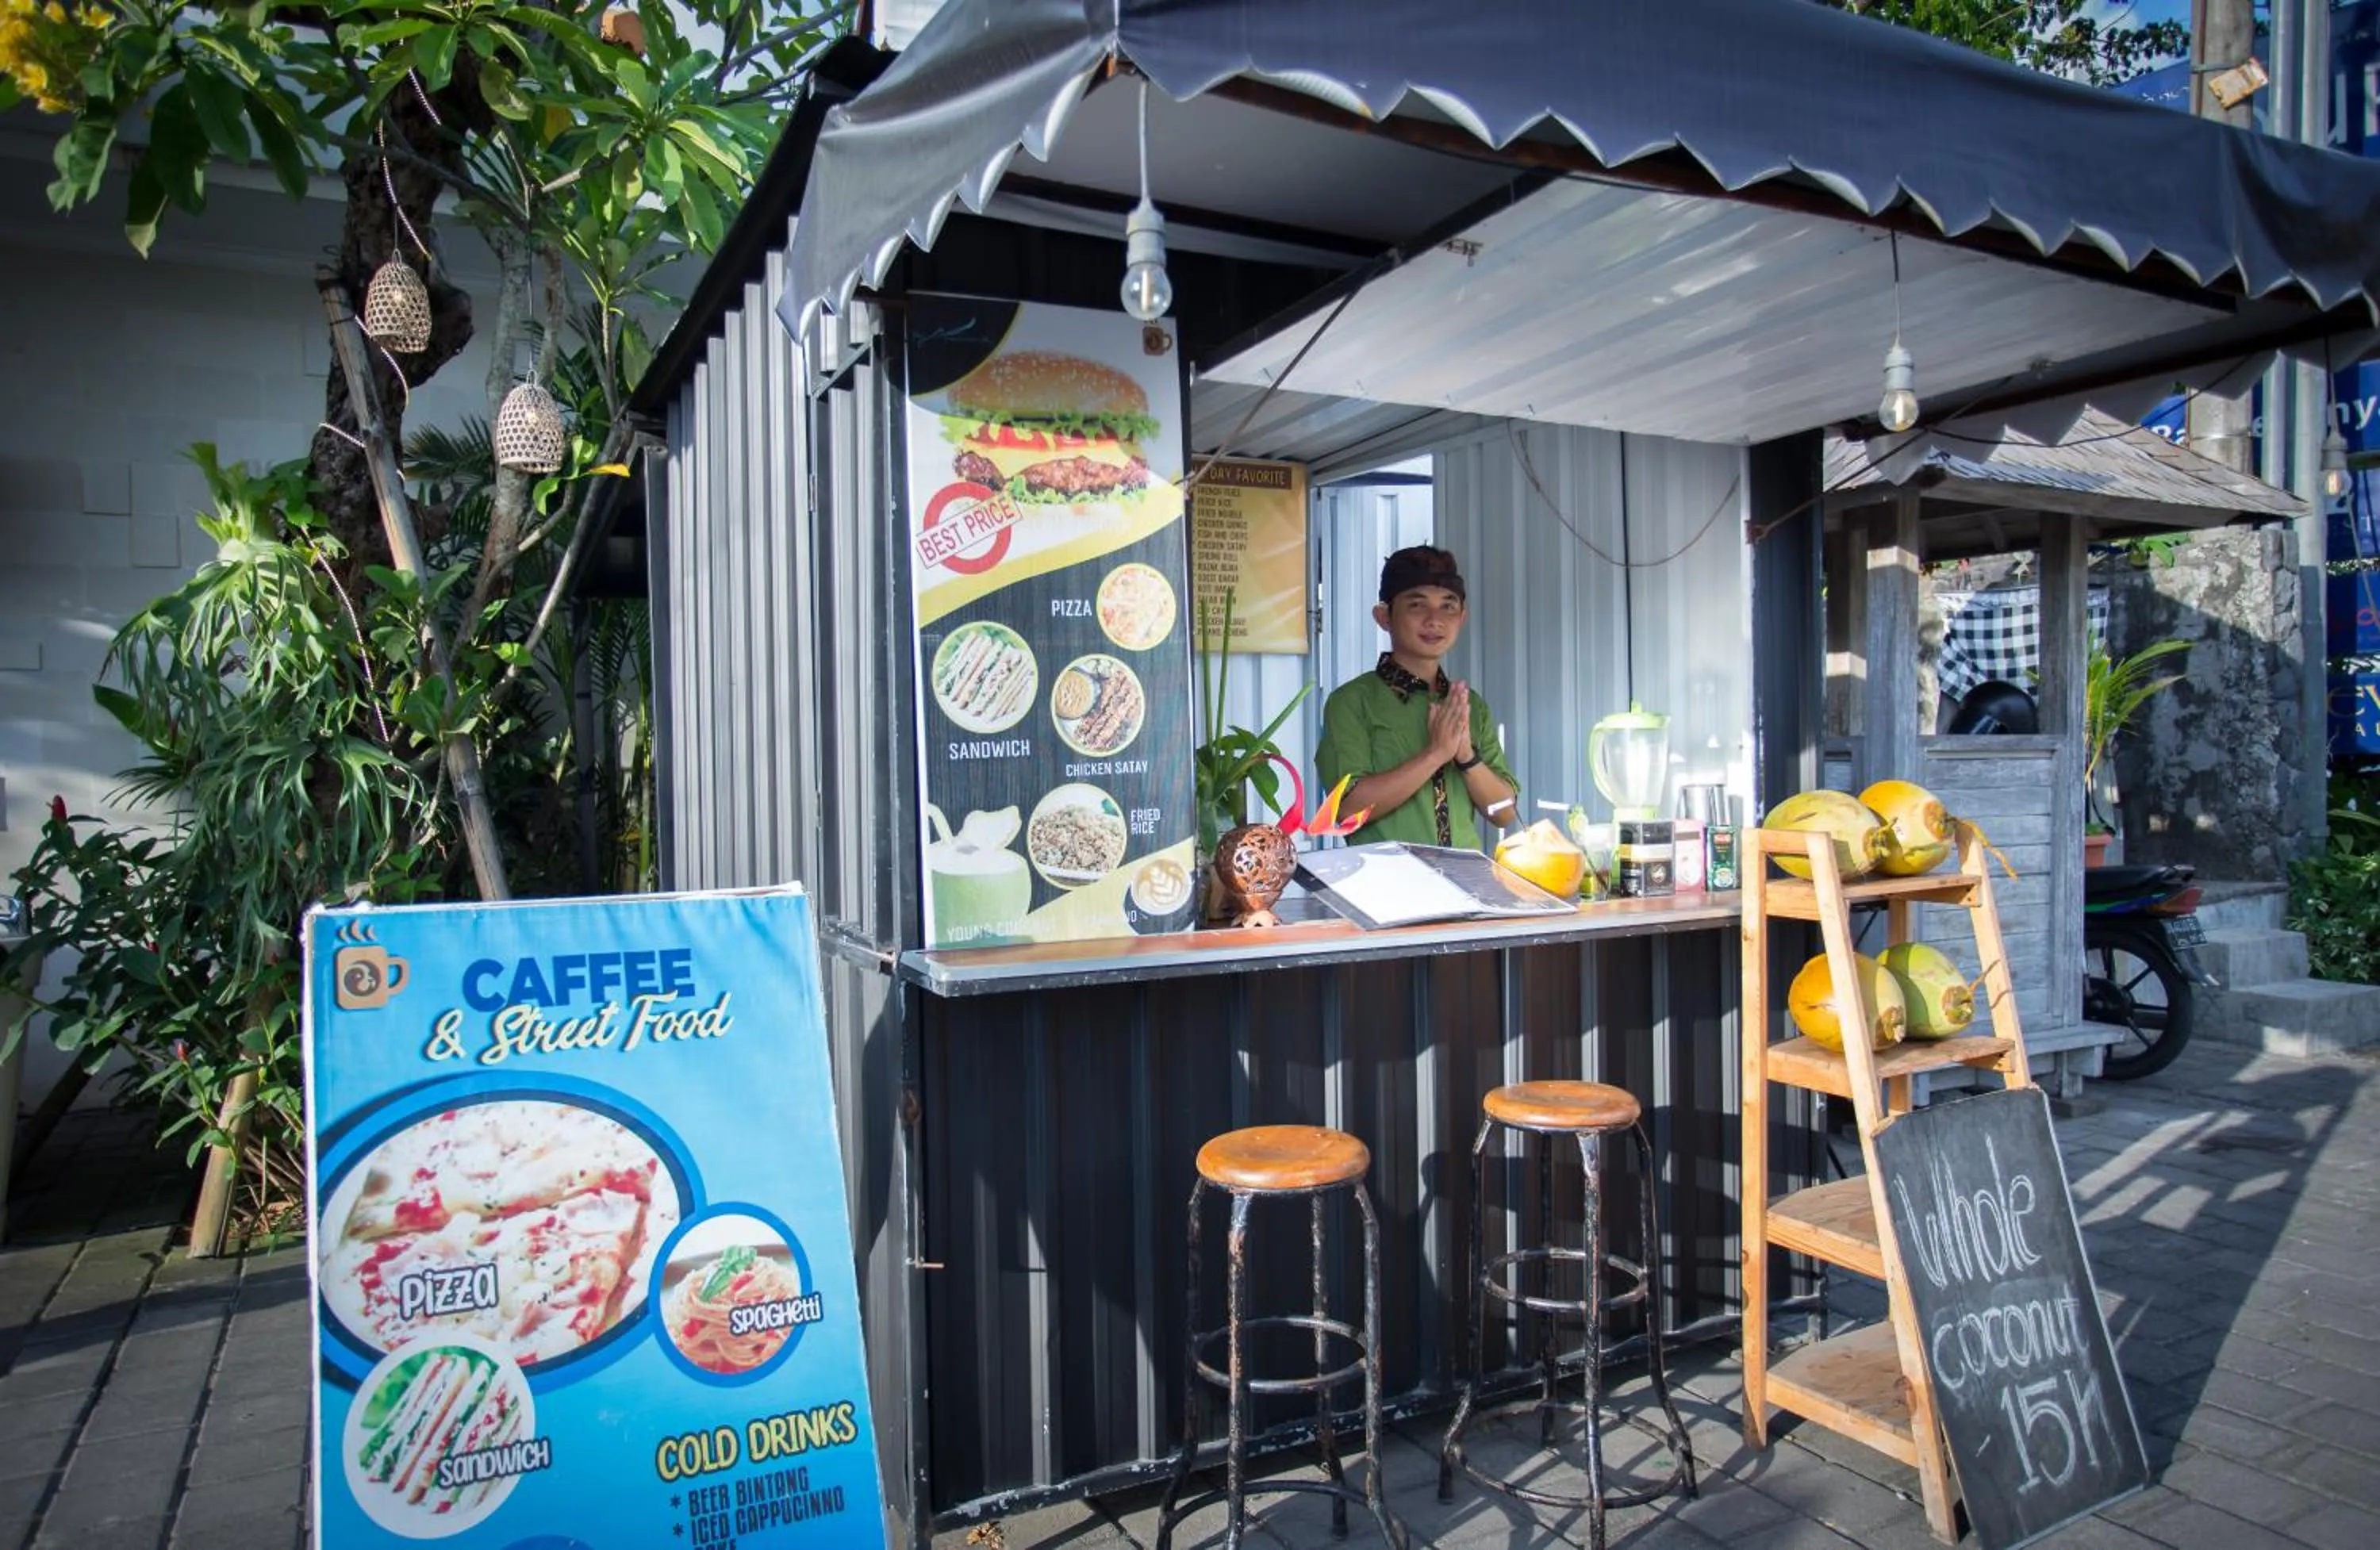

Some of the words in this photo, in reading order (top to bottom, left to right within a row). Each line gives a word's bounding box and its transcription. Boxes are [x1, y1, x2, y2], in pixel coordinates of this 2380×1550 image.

[1237, 468, 1285, 485] FAVORITE
[919, 523, 965, 562] BEST
[964, 496, 1015, 538] PRICE
[1051, 599, 1092, 617] PIZZA
[949, 739, 1031, 761] SANDWICH
[1065, 763, 1111, 777] CHICKEN
[1114, 761, 1149, 775] SATAY
[1130, 808, 1161, 822] FRIED
[1130, 822, 1154, 835] RICE
[462, 948, 696, 1013] CAFFEE
[423, 1009, 466, 1062] &
[477, 1000, 624, 1065] Street
[622, 989, 735, 1052] Food
[656, 1424, 741, 1483] COLD
[747, 1400, 858, 1464] DRINKS
[688, 1484, 731, 1517] BEER
[735, 1466, 810, 1506] BINTANG
[690, 1512, 731, 1546] ICED
[735, 1485, 846, 1536] CAPPUCINNO
